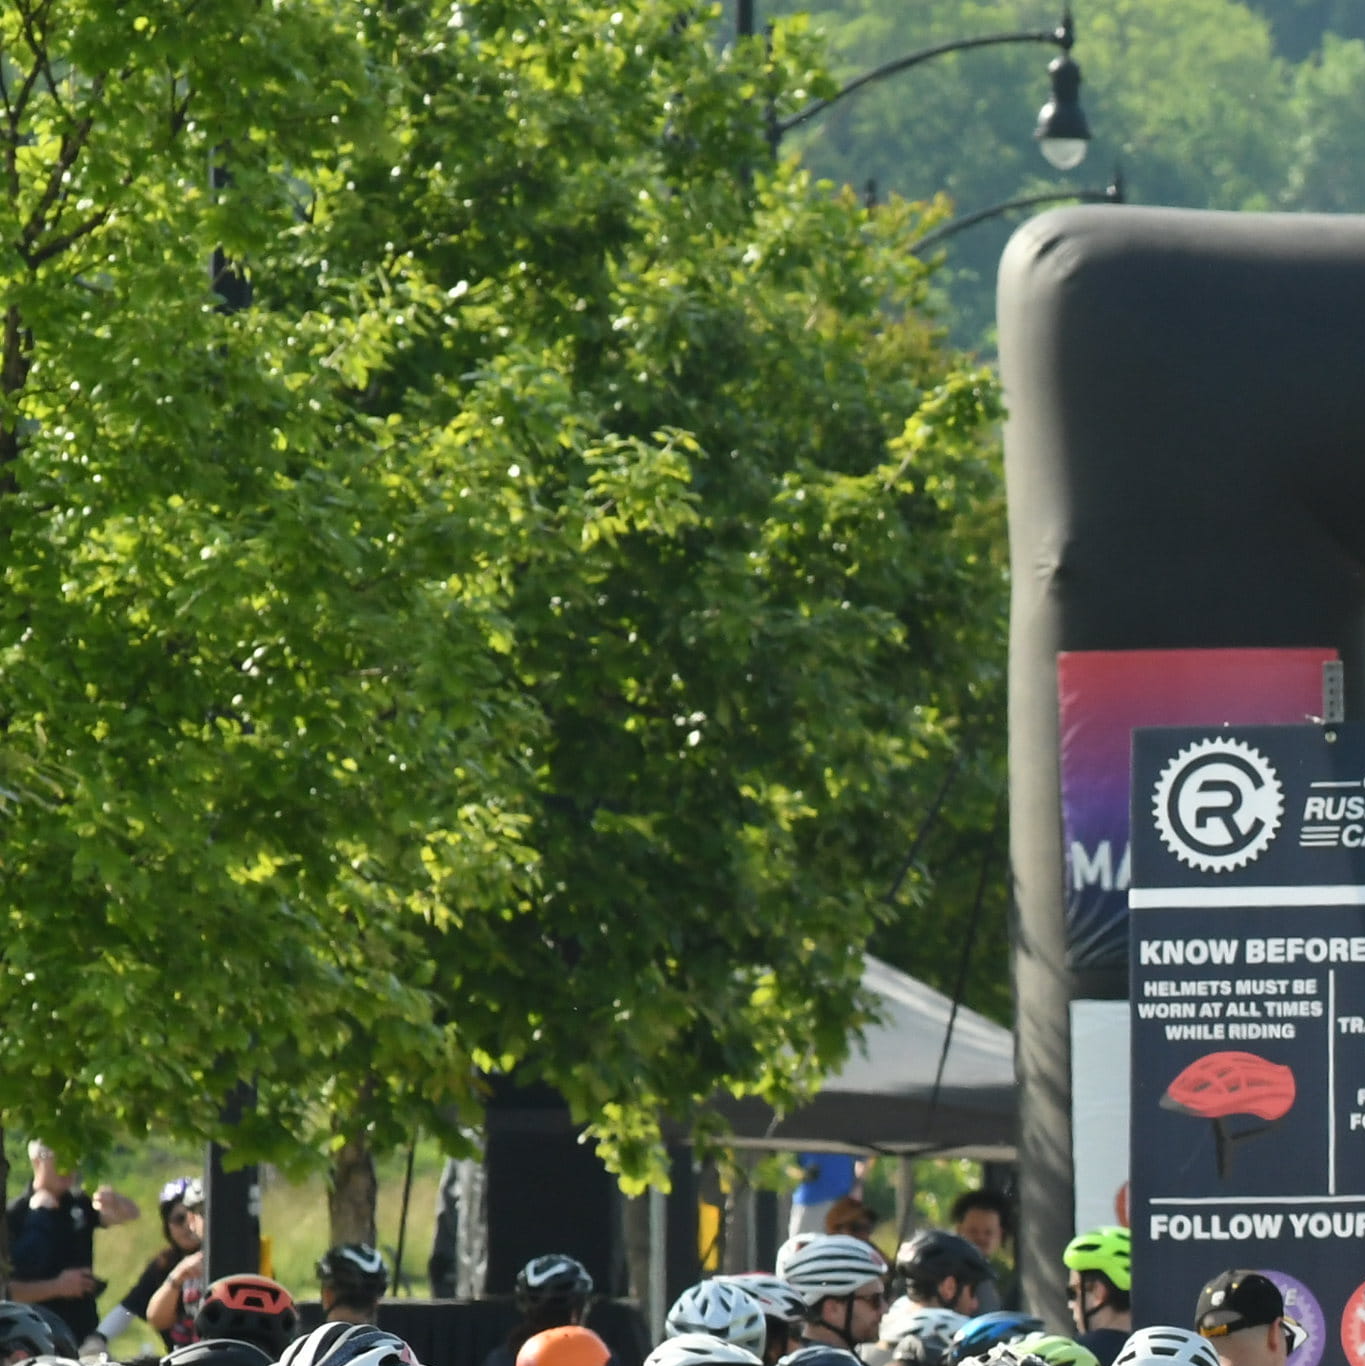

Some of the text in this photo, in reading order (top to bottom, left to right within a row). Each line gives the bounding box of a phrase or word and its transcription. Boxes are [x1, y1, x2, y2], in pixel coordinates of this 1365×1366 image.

[1139, 938, 1238, 964] KNOW
[1143, 979, 1317, 997] HELMETS MUST BE
[1138, 1001, 1323, 1019] WORN AT ALL TIMES
[1165, 1023, 1297, 1040] WHILE RIDING
[1149, 1213, 1283, 1240] FOLLOW
